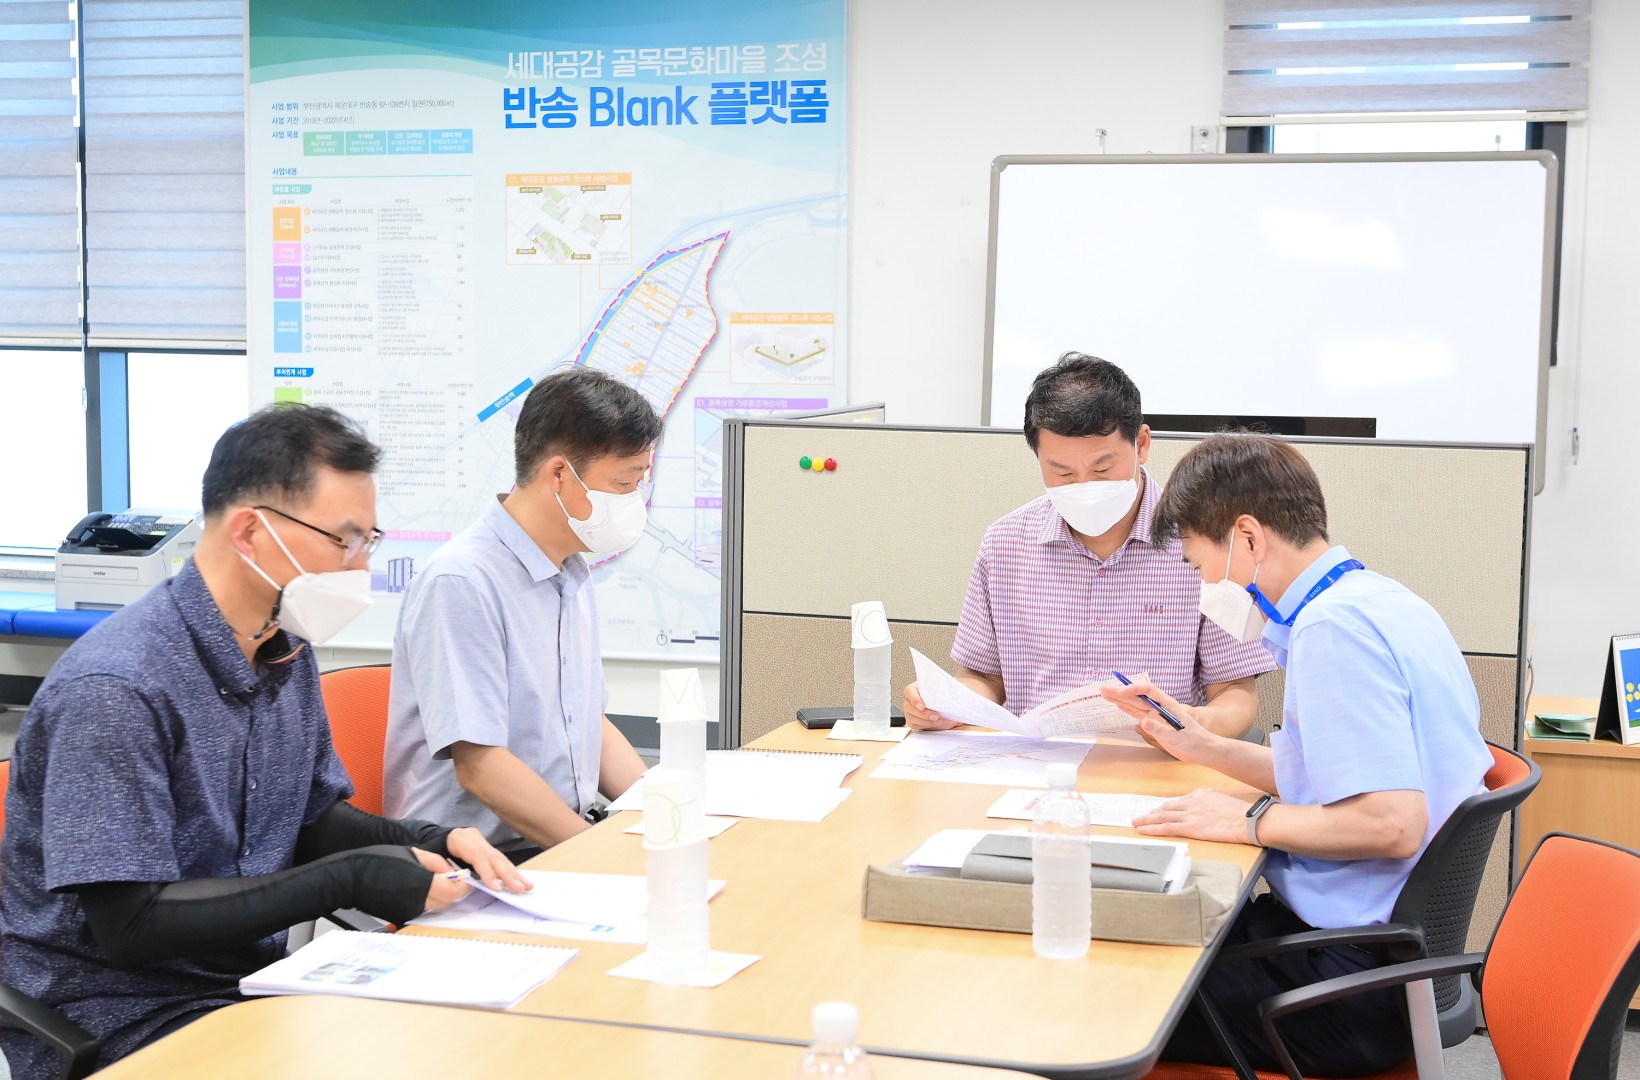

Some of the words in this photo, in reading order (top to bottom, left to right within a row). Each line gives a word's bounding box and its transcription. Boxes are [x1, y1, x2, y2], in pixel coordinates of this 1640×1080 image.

[504, 50, 605, 80] 세대공감
[611, 44, 767, 77] 골목문화마을
[774, 42, 828, 73] 조성
[271, 102, 285, 111] 사업
[302, 101, 333, 110] 부산광역시
[503, 86, 579, 129] 반송
[589, 85, 699, 127] Blank
[708, 79, 829, 126] 플랫폼
[271, 116, 285, 125] 사업
[286, 116, 299, 125] 기간
[271, 131, 285, 139] 사업
[286, 131, 299, 139] 목표
[272, 168, 298, 176] 사업내용
